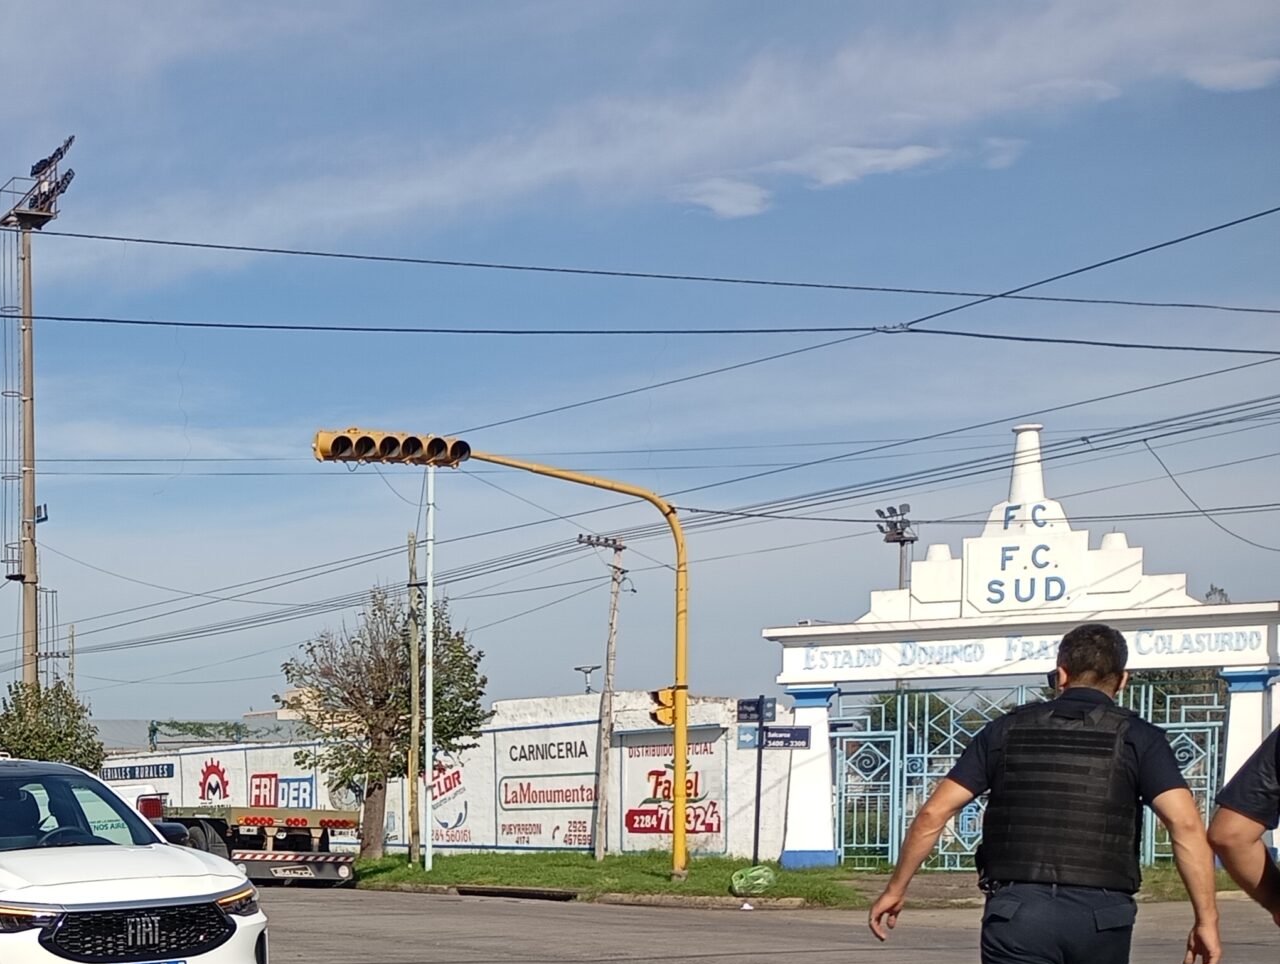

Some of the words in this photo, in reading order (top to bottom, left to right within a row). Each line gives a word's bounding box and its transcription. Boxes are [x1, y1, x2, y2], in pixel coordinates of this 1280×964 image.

[986, 576, 1070, 604] SUD.
[509, 740, 588, 761] CARNICERIA
[628, 744, 674, 758] DISTRIBUIDO
[687, 742, 714, 756] FICIAL
[135, 765, 168, 778] RURALES
[647, 770, 699, 801] Fael
[633, 815, 658, 828] 2284
[658, 801, 719, 832] 71324
[127, 916, 160, 946] FIAT
